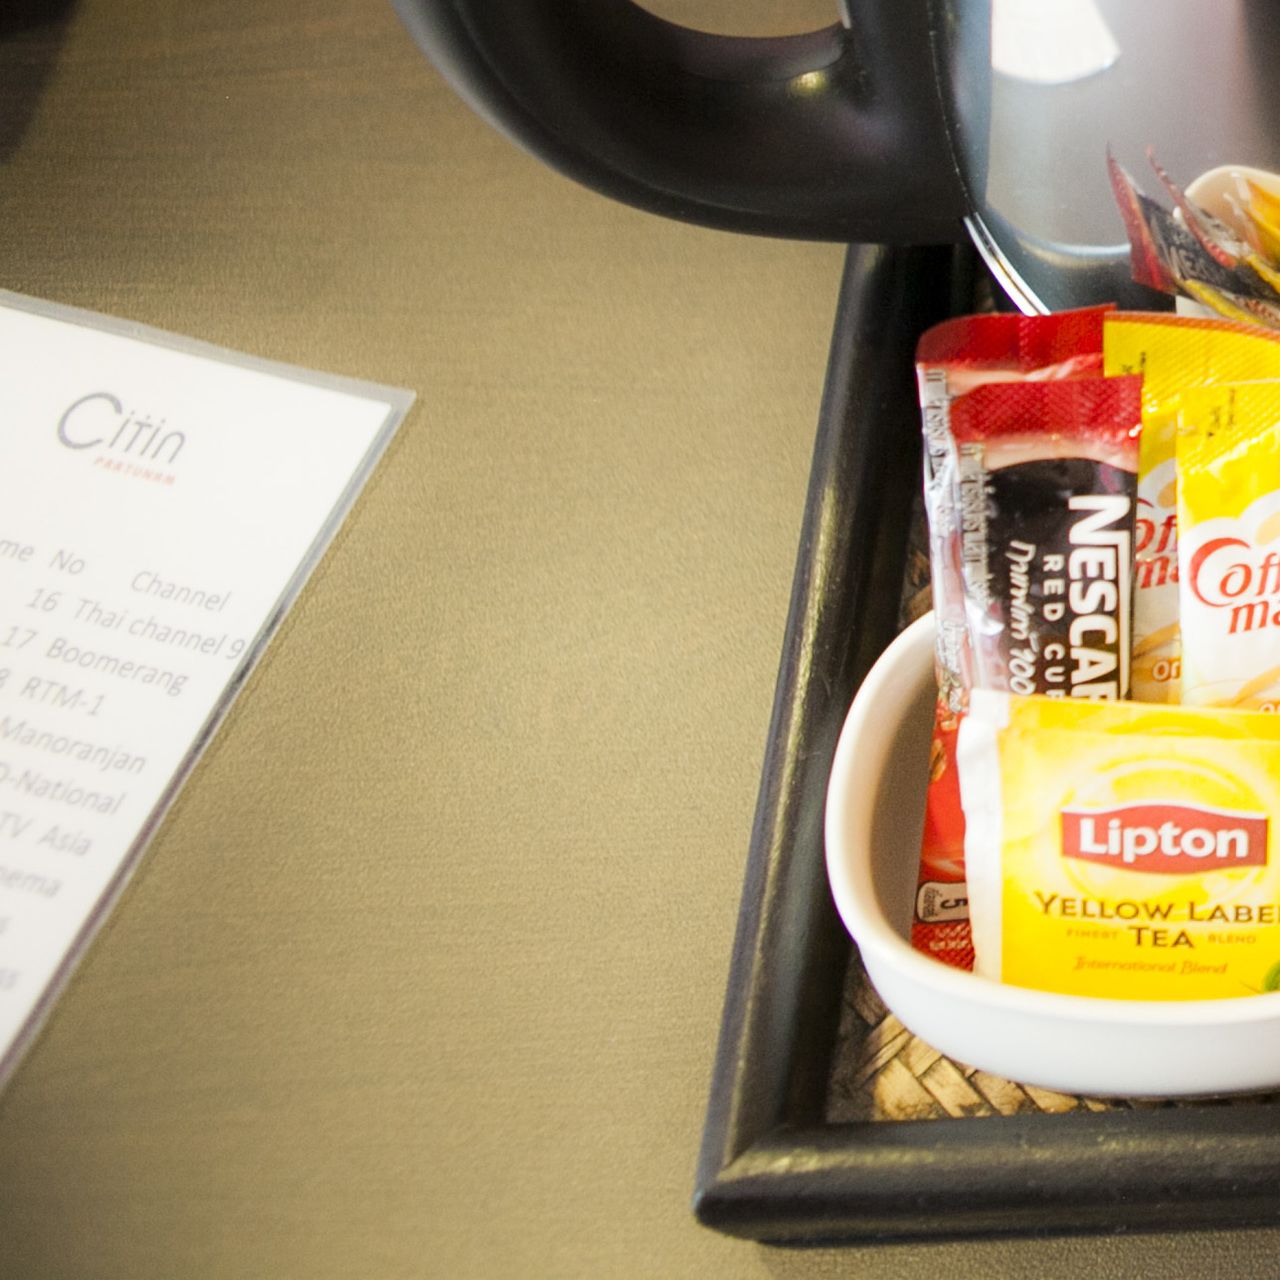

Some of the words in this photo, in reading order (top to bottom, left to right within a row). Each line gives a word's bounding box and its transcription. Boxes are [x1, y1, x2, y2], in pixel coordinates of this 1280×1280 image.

[49, 549, 86, 576] No
[130, 569, 232, 613] Channel
[1042, 554, 1066, 622] RED
[25, 587, 61, 613] 16
[73, 597, 129, 631] Thai
[127, 615, 228, 656] channel
[226, 637, 247, 661] 9
[1, 625, 39, 651] 17
[45, 636, 190, 698] Boomerang
[1078, 816, 1251, 864] Lipton
[1033, 889, 1175, 921] YELLOW
[1127, 925, 1196, 949] TEA
